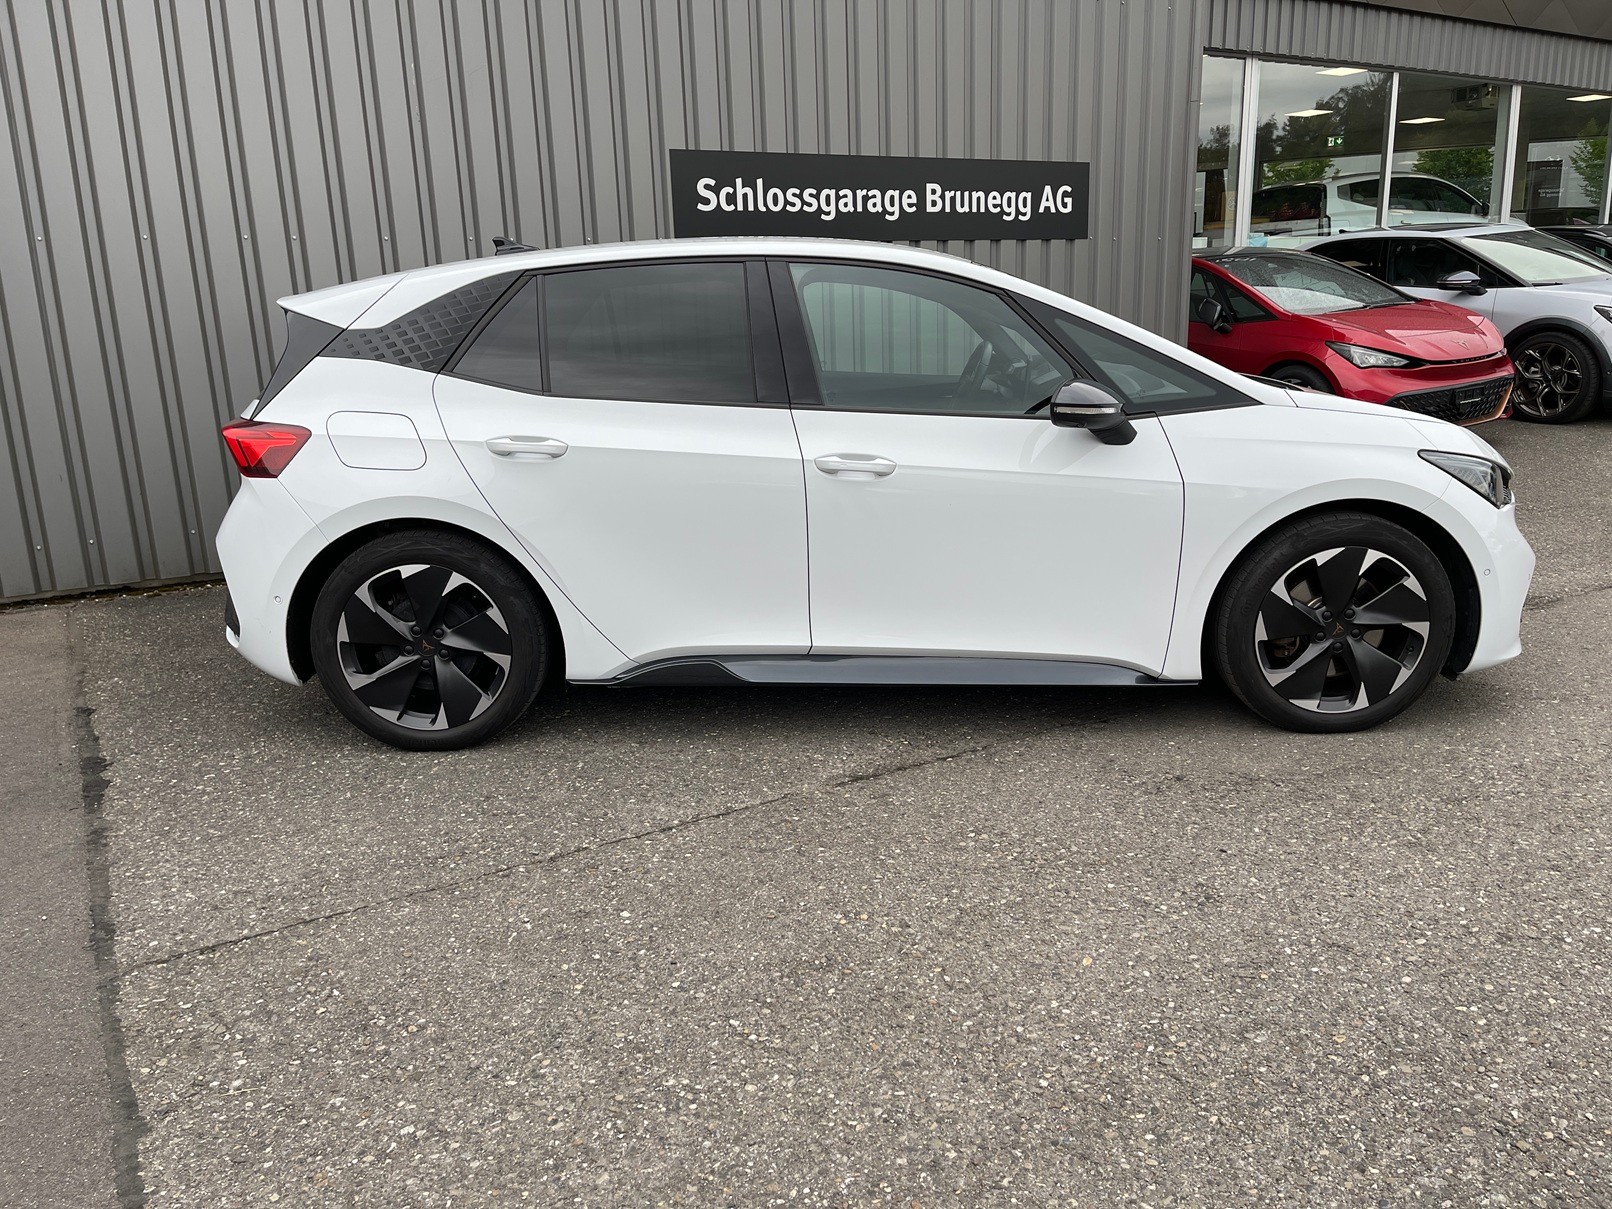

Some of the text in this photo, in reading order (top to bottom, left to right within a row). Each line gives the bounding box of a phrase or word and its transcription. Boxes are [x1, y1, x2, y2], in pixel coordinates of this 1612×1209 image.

[696, 177, 1073, 222] Schlossgarage Brunegg AG
